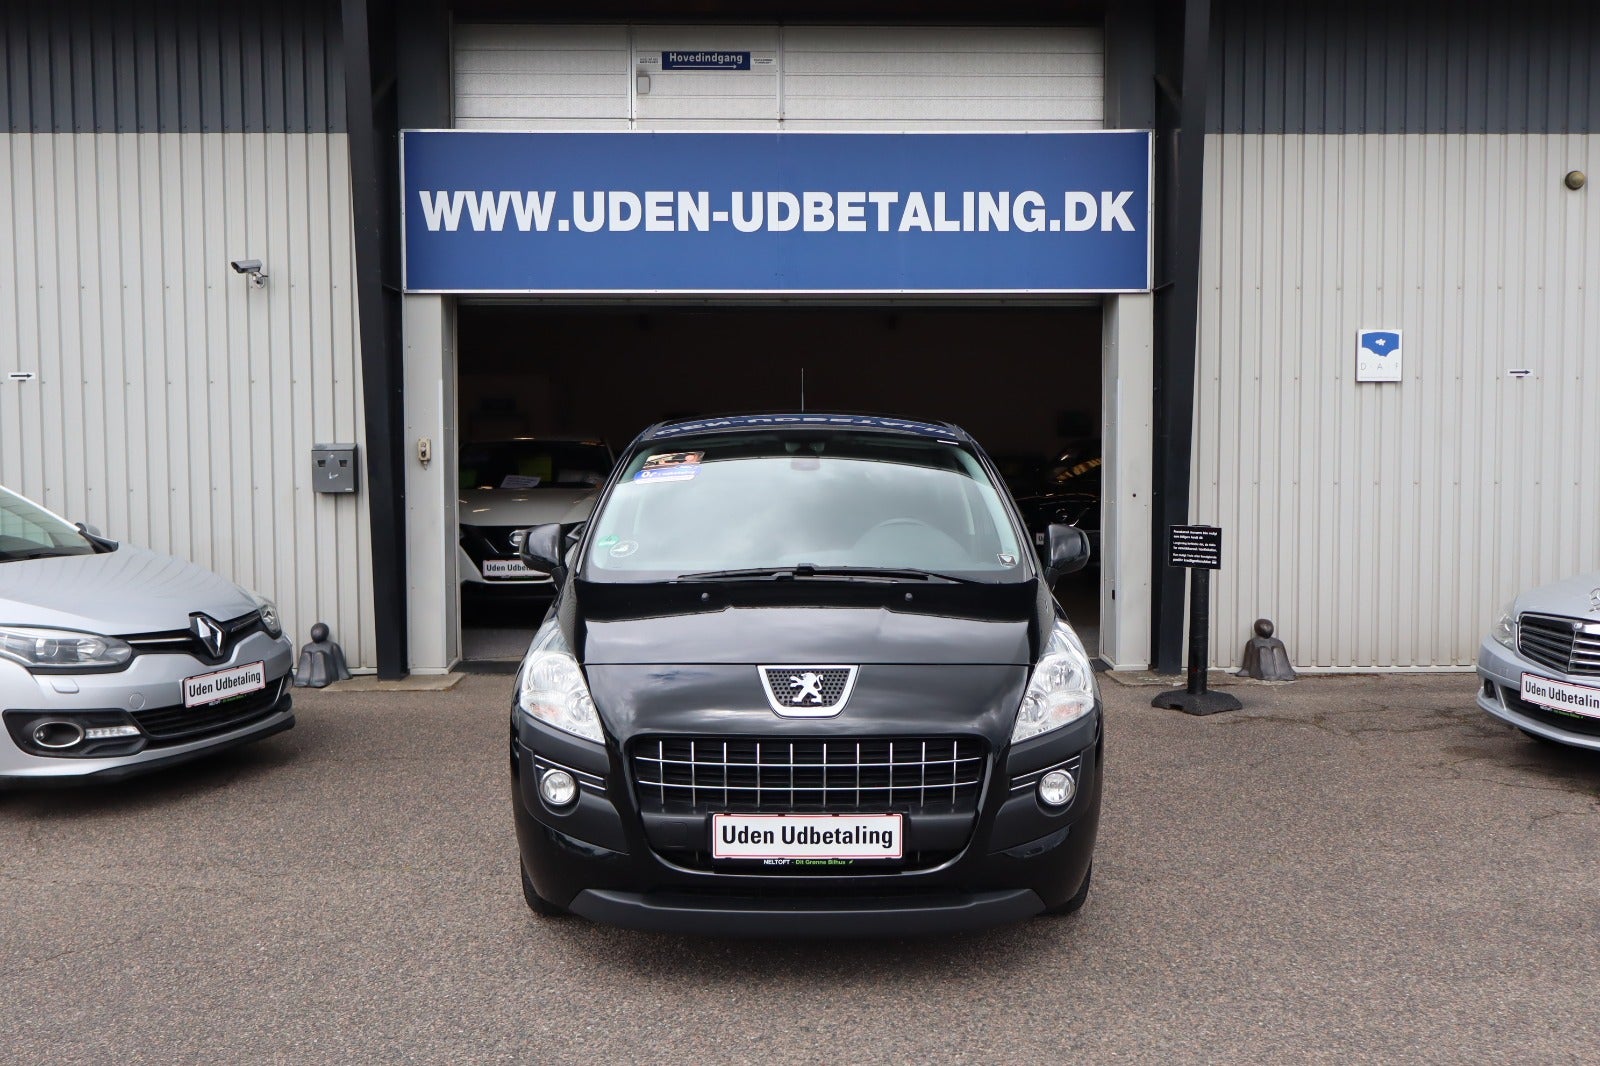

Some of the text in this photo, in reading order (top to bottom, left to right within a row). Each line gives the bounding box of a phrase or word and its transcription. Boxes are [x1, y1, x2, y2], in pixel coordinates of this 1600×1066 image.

[669, 53, 743, 64] Hovedindgang
[419, 190, 1135, 233] WWW.UDEN-UDBETALING.DK
[486, 564, 506, 572] Uden
[189, 672, 261, 697] Uden Udbetaling
[1525, 681, 1600, 708] Uden Udbetalin
[722, 825, 893, 849] Uden Udbetaling
